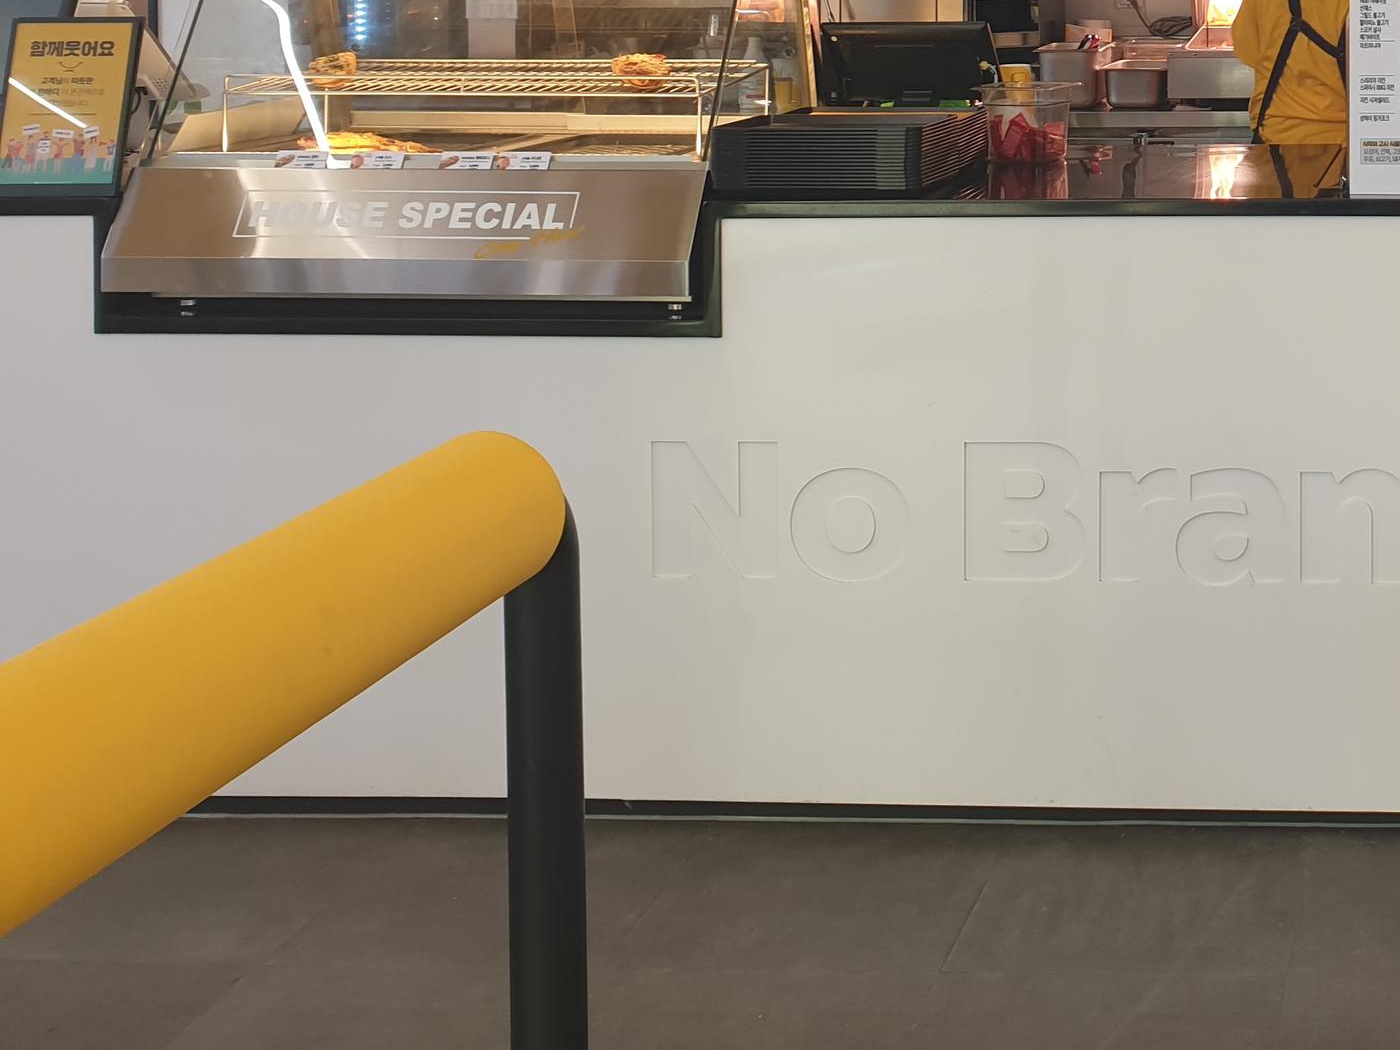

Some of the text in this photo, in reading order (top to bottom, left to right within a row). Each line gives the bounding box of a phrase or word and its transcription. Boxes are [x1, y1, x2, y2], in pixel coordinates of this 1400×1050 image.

[30, 40, 115, 57] 함께웃어요
[248, 200, 565, 230] HOUSE SPECIAL
[650, 439, 912, 583] No
